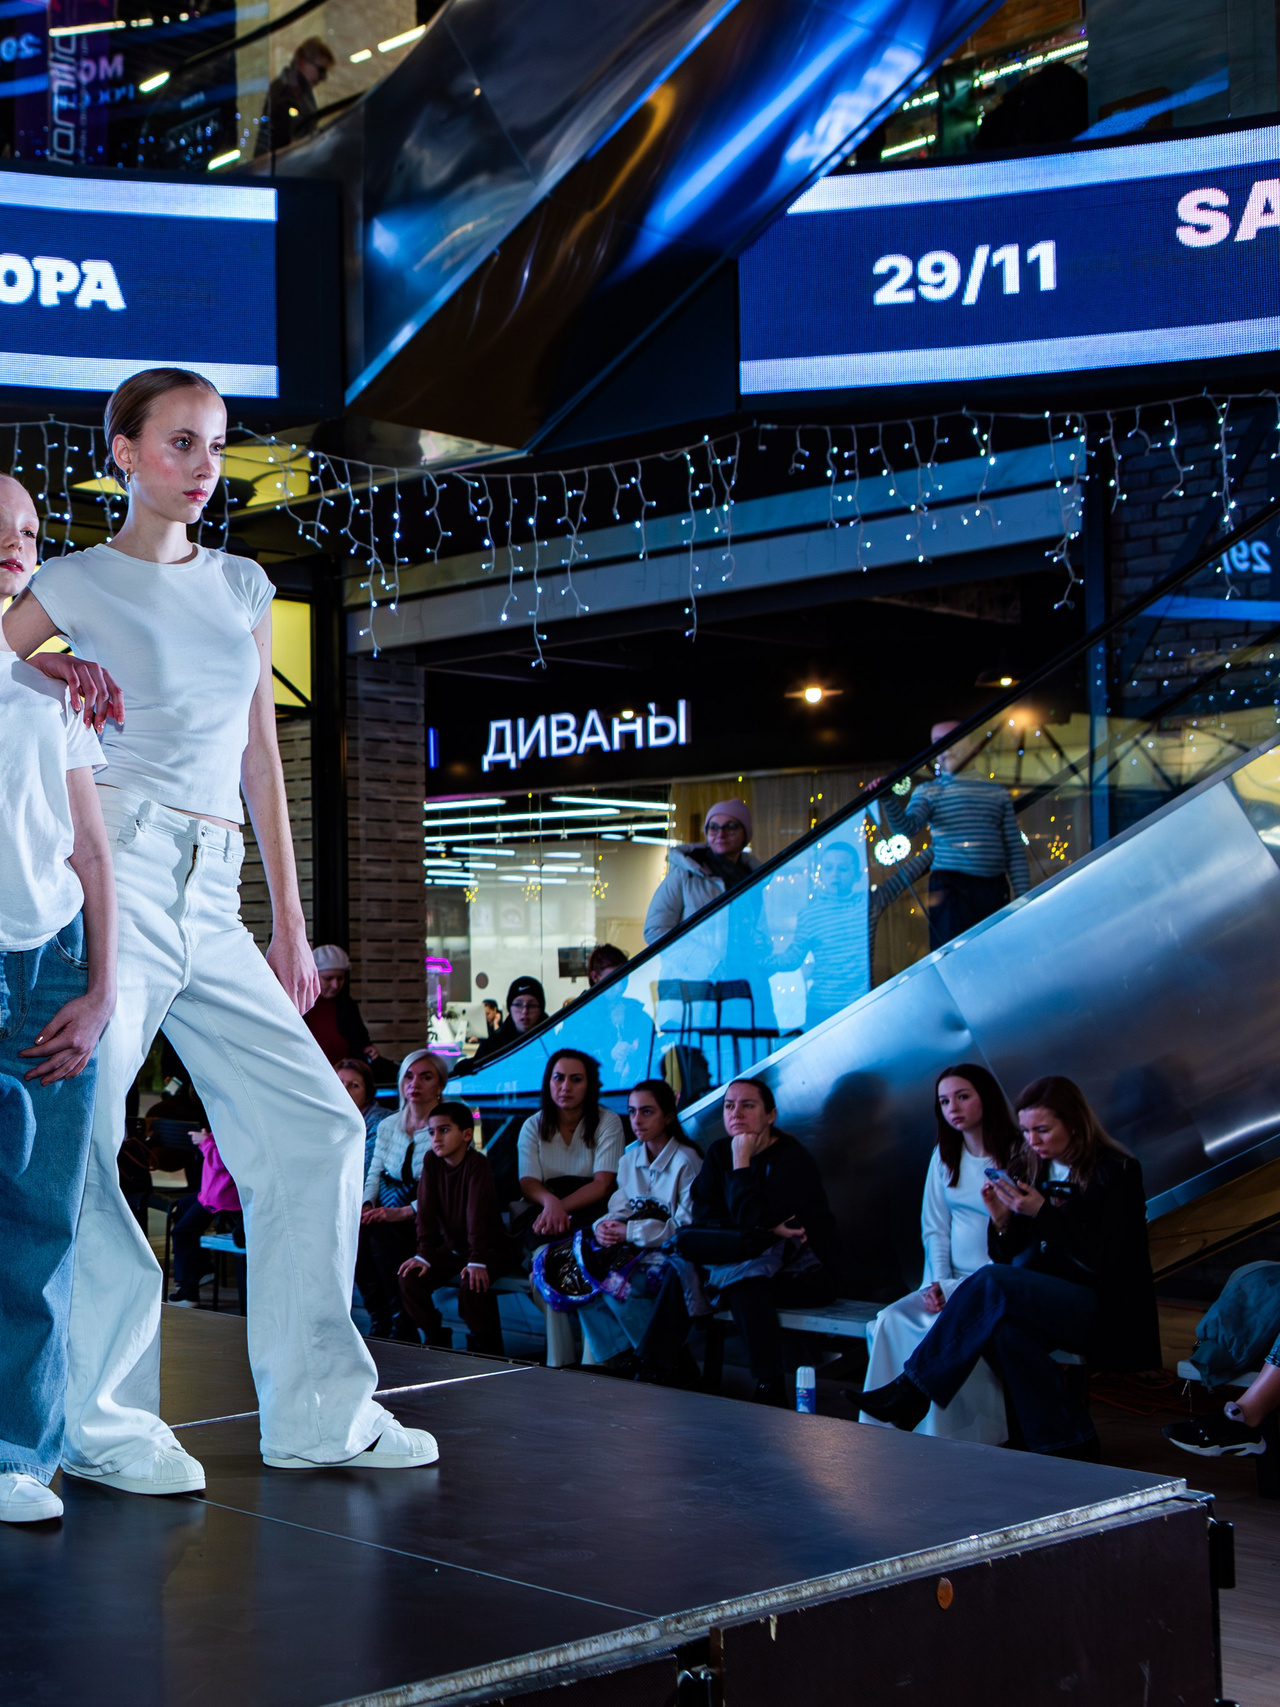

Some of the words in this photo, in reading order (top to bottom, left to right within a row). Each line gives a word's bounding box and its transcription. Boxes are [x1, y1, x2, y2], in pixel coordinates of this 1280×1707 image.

[1176, 179, 1280, 248] SA
[872, 239, 1056, 306] 29/11
[482, 699, 687, 772] ДИВАНЫ
